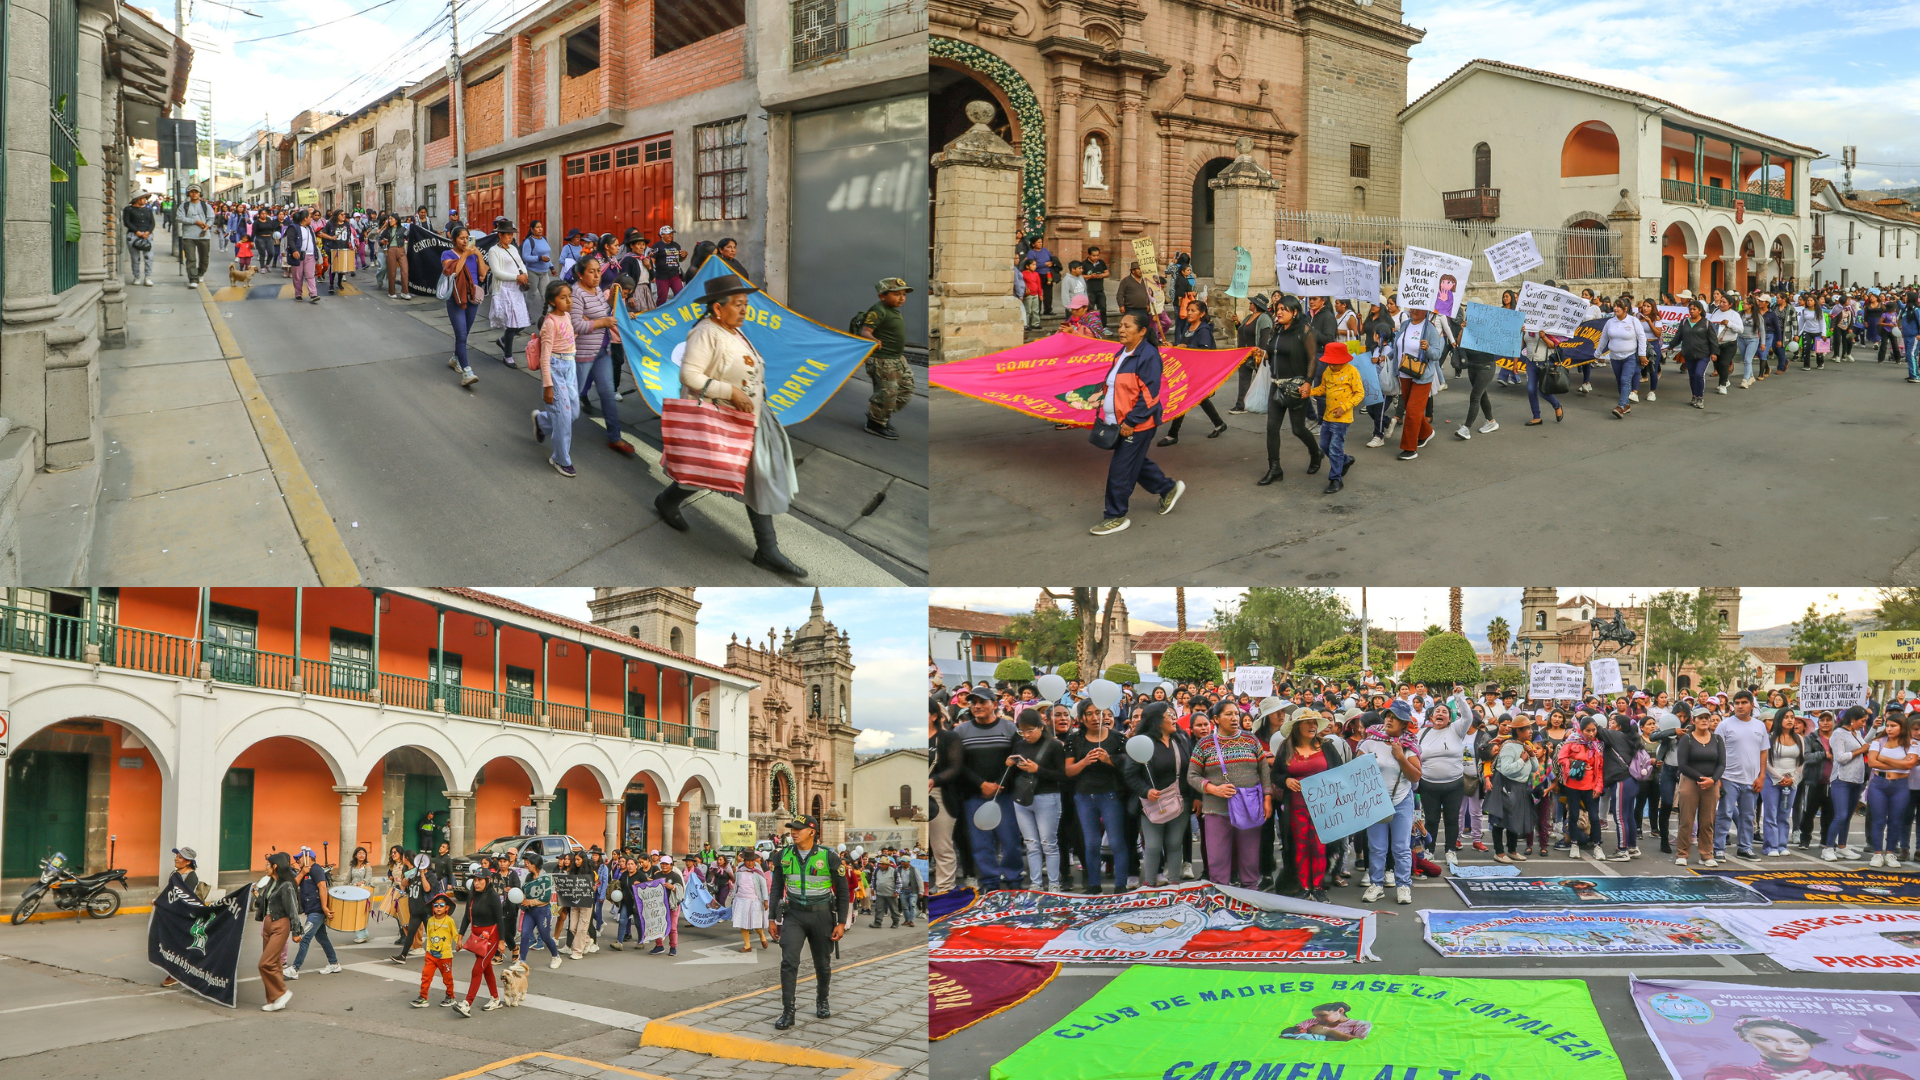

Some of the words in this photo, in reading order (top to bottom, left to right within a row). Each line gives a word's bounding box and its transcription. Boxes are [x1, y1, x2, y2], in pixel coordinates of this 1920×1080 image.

[1282, 243, 1289, 251] DE
[1292, 245, 1311, 253] CAMINO
[1287, 262, 1298, 271] SER
[644, 312, 677, 336] LAS
[996, 358, 1059, 374] COMITE
[766, 359, 830, 415] YRAPATA
[1819, 664, 1831, 674] EL
[1805, 674, 1849, 685] FEMINICIDIO
[1801, 685, 1809, 693] ES
[1311, 802, 1327, 818] no
[1324, 812, 1345, 829] un
[1039, 949, 1148, 959] DISTRITO
[1152, 950, 1181, 959] DE
[1184, 950, 1290, 960] CARMEN
[1291, 950, 1347, 959] ALTO
[1444, 945, 1498, 953] VASO
[1502, 945, 1534, 953] DE
[1718, 993, 1812, 1004] Municipalidad
[1813, 996, 1869, 1004] Distrital
[1053, 1006, 1141, 1040] CLUB
[1150, 995, 1191, 1011] DE
[1198, 980, 1315, 1003] MADRES
[1331, 980, 1404, 993] BASE
[1710, 998, 1825, 1011] CARMEN
[1831, 1002, 1894, 1013] ALTO
[1162, 1060, 1346, 1080] CARMEN
